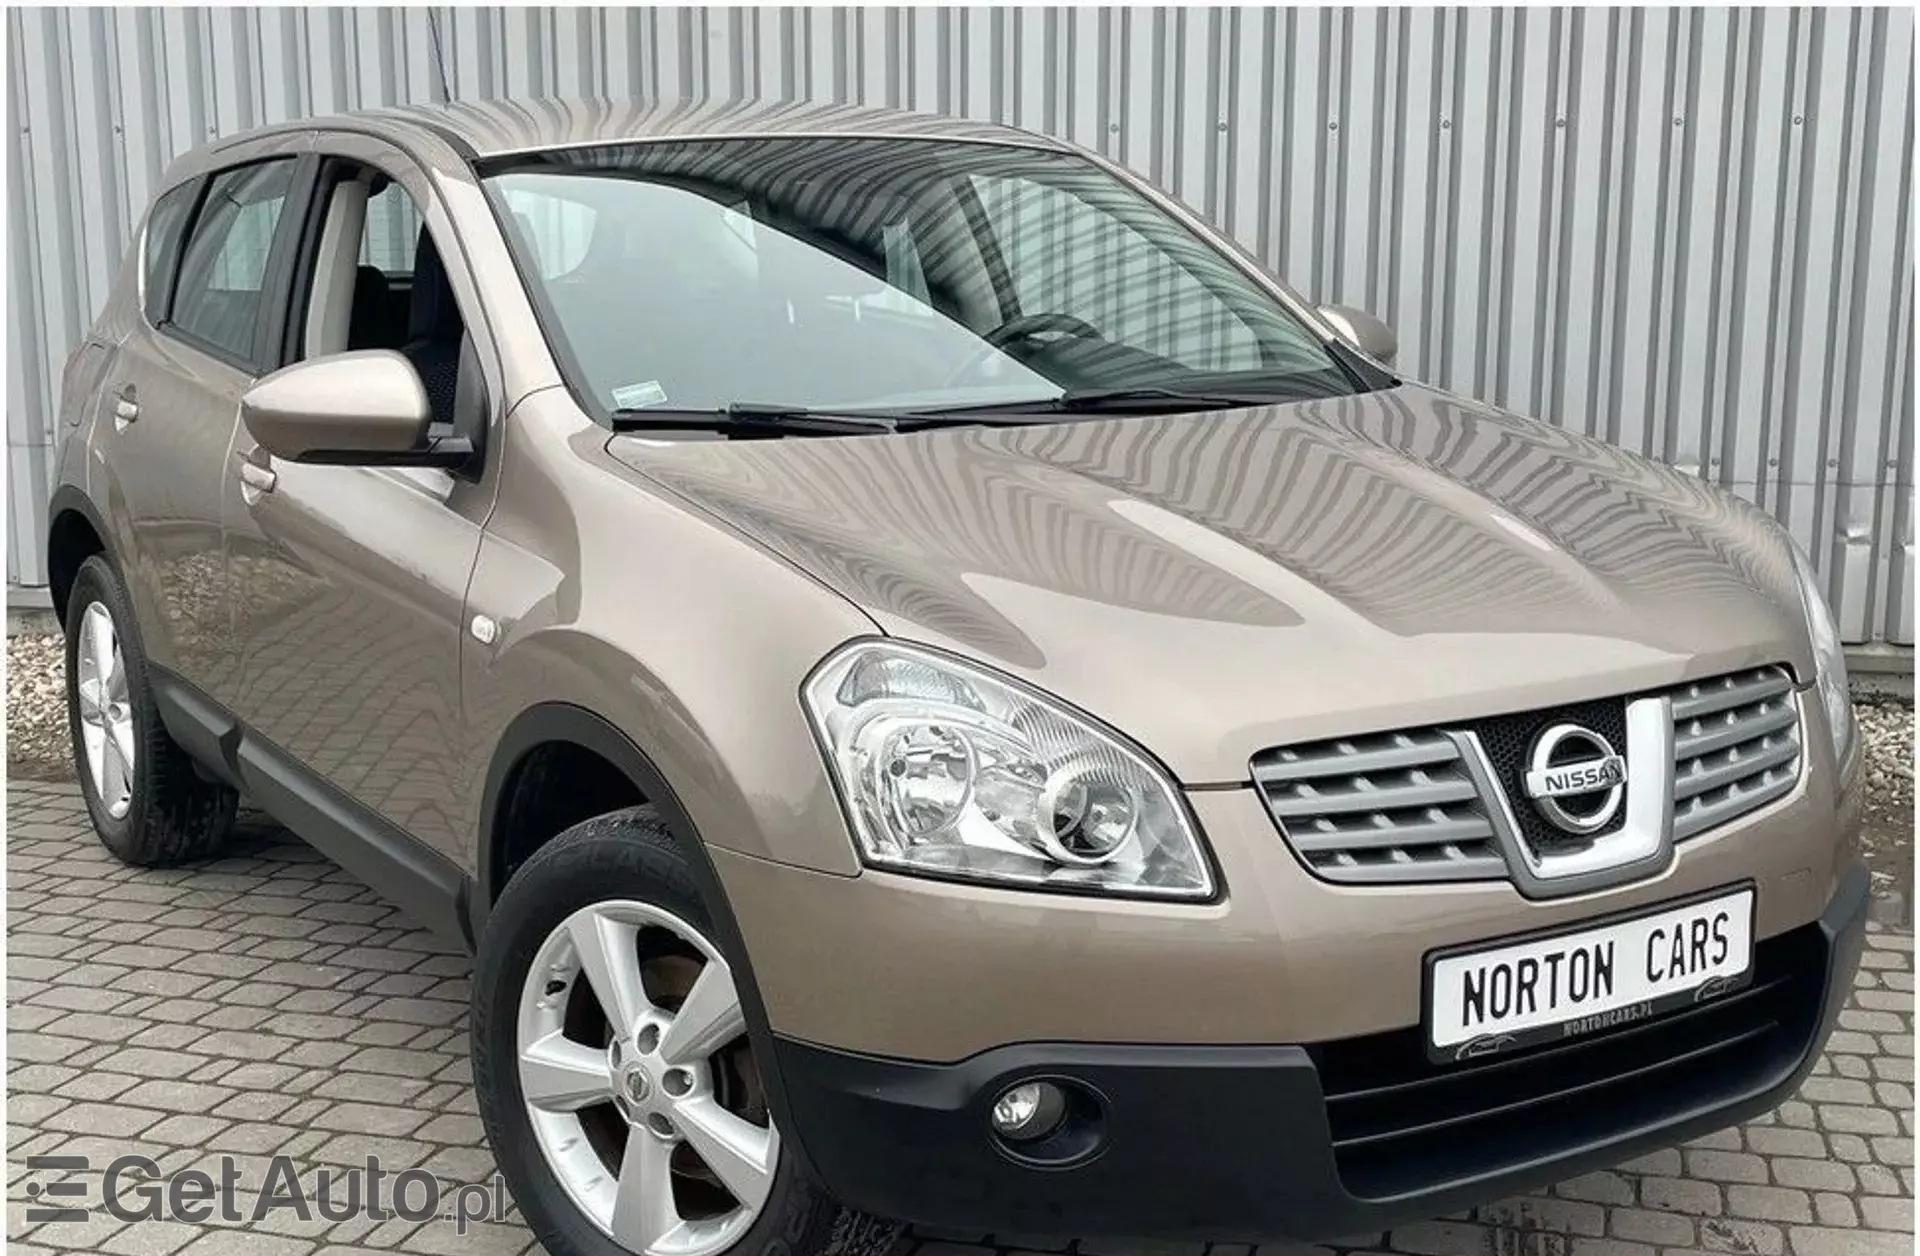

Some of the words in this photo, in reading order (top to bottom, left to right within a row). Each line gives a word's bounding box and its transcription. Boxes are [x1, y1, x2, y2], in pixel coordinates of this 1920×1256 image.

[1545, 764, 1621, 792] NISSAN
[1462, 940, 1614, 1027] NORTON
[1646, 912, 1729, 983] CARS
